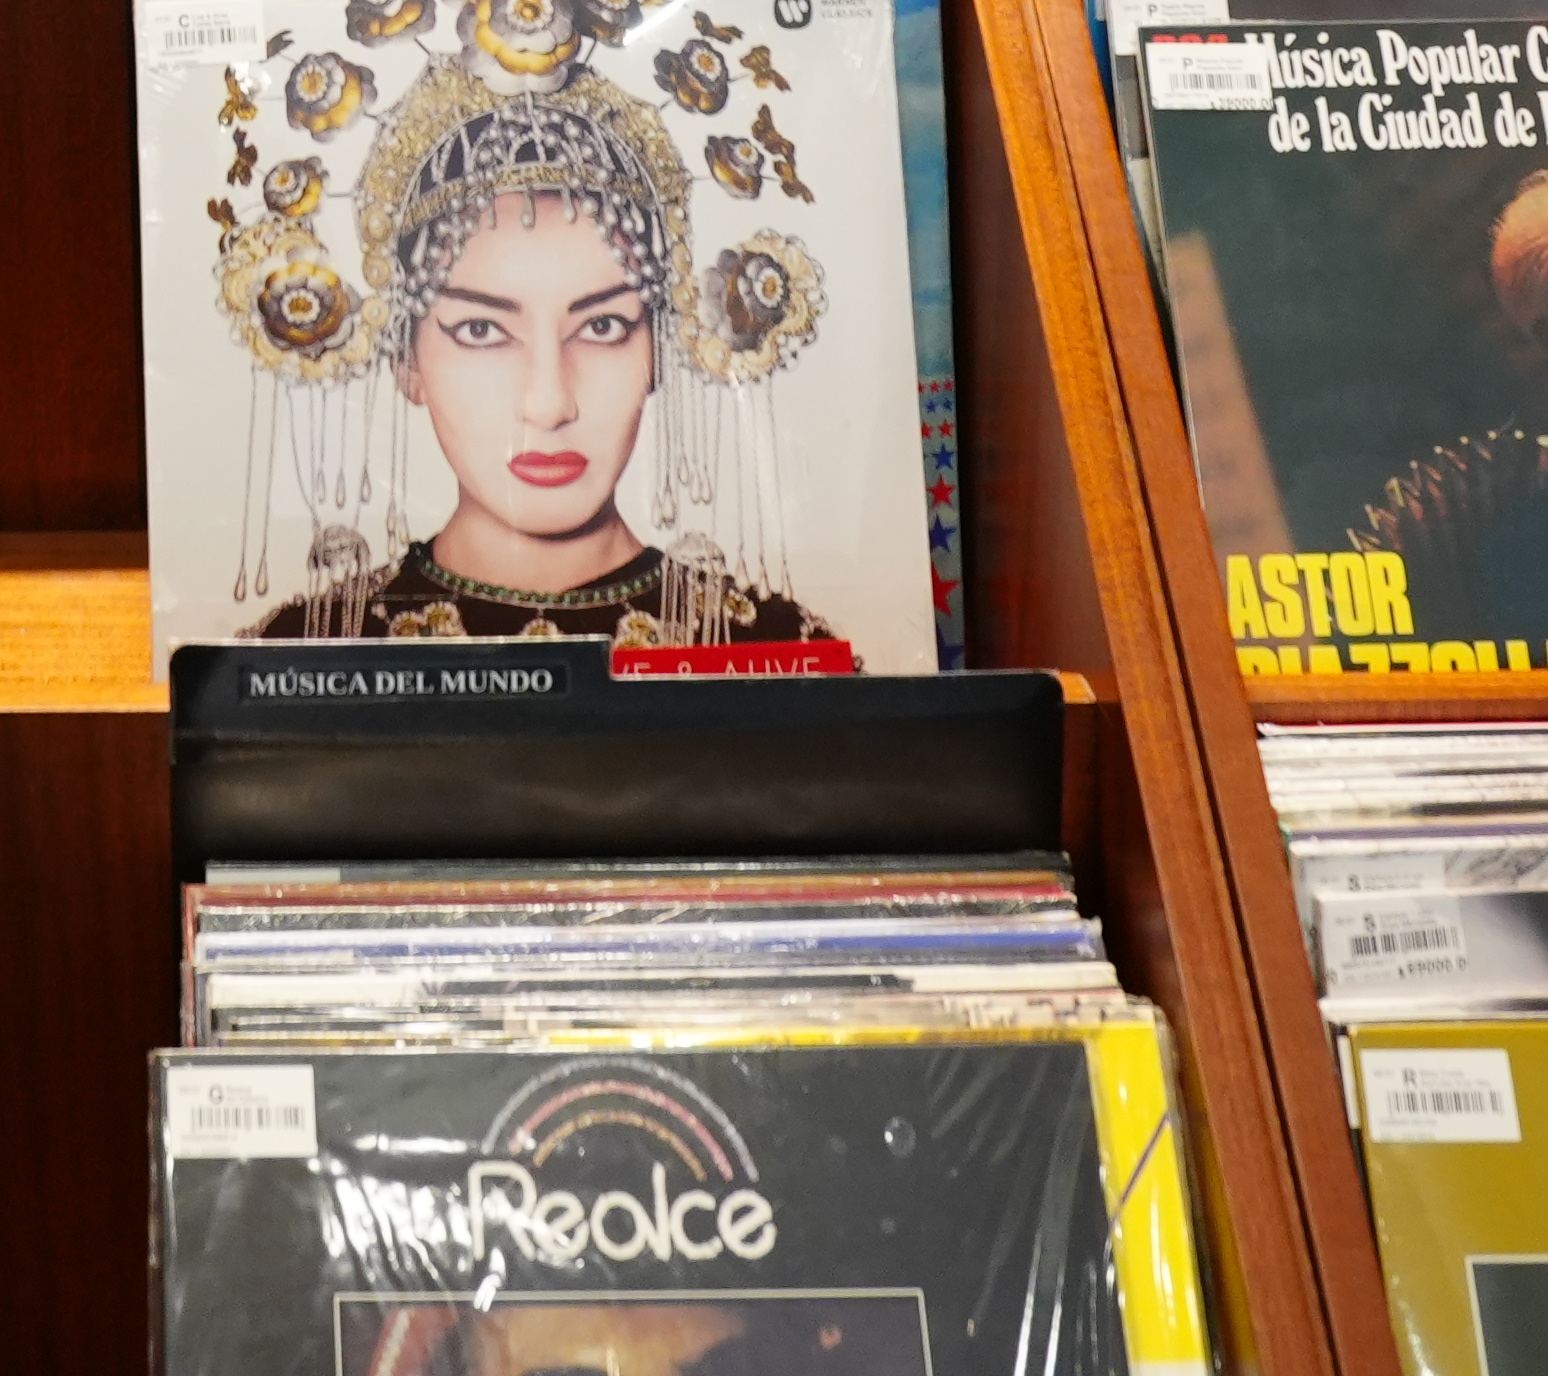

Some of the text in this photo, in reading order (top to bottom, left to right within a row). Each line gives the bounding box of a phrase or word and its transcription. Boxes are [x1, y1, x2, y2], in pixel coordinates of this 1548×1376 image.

[1385, 28, 1521, 94] Popular
[1269, 99, 1311, 153] de
[1319, 98, 1356, 150] la
[1358, 90, 1485, 150] Ciudad
[1498, 90, 1539, 147] de
[1227, 554, 1414, 640] ASTOR
[249, 666, 552, 698] MÚSICA DEL MUNDO
